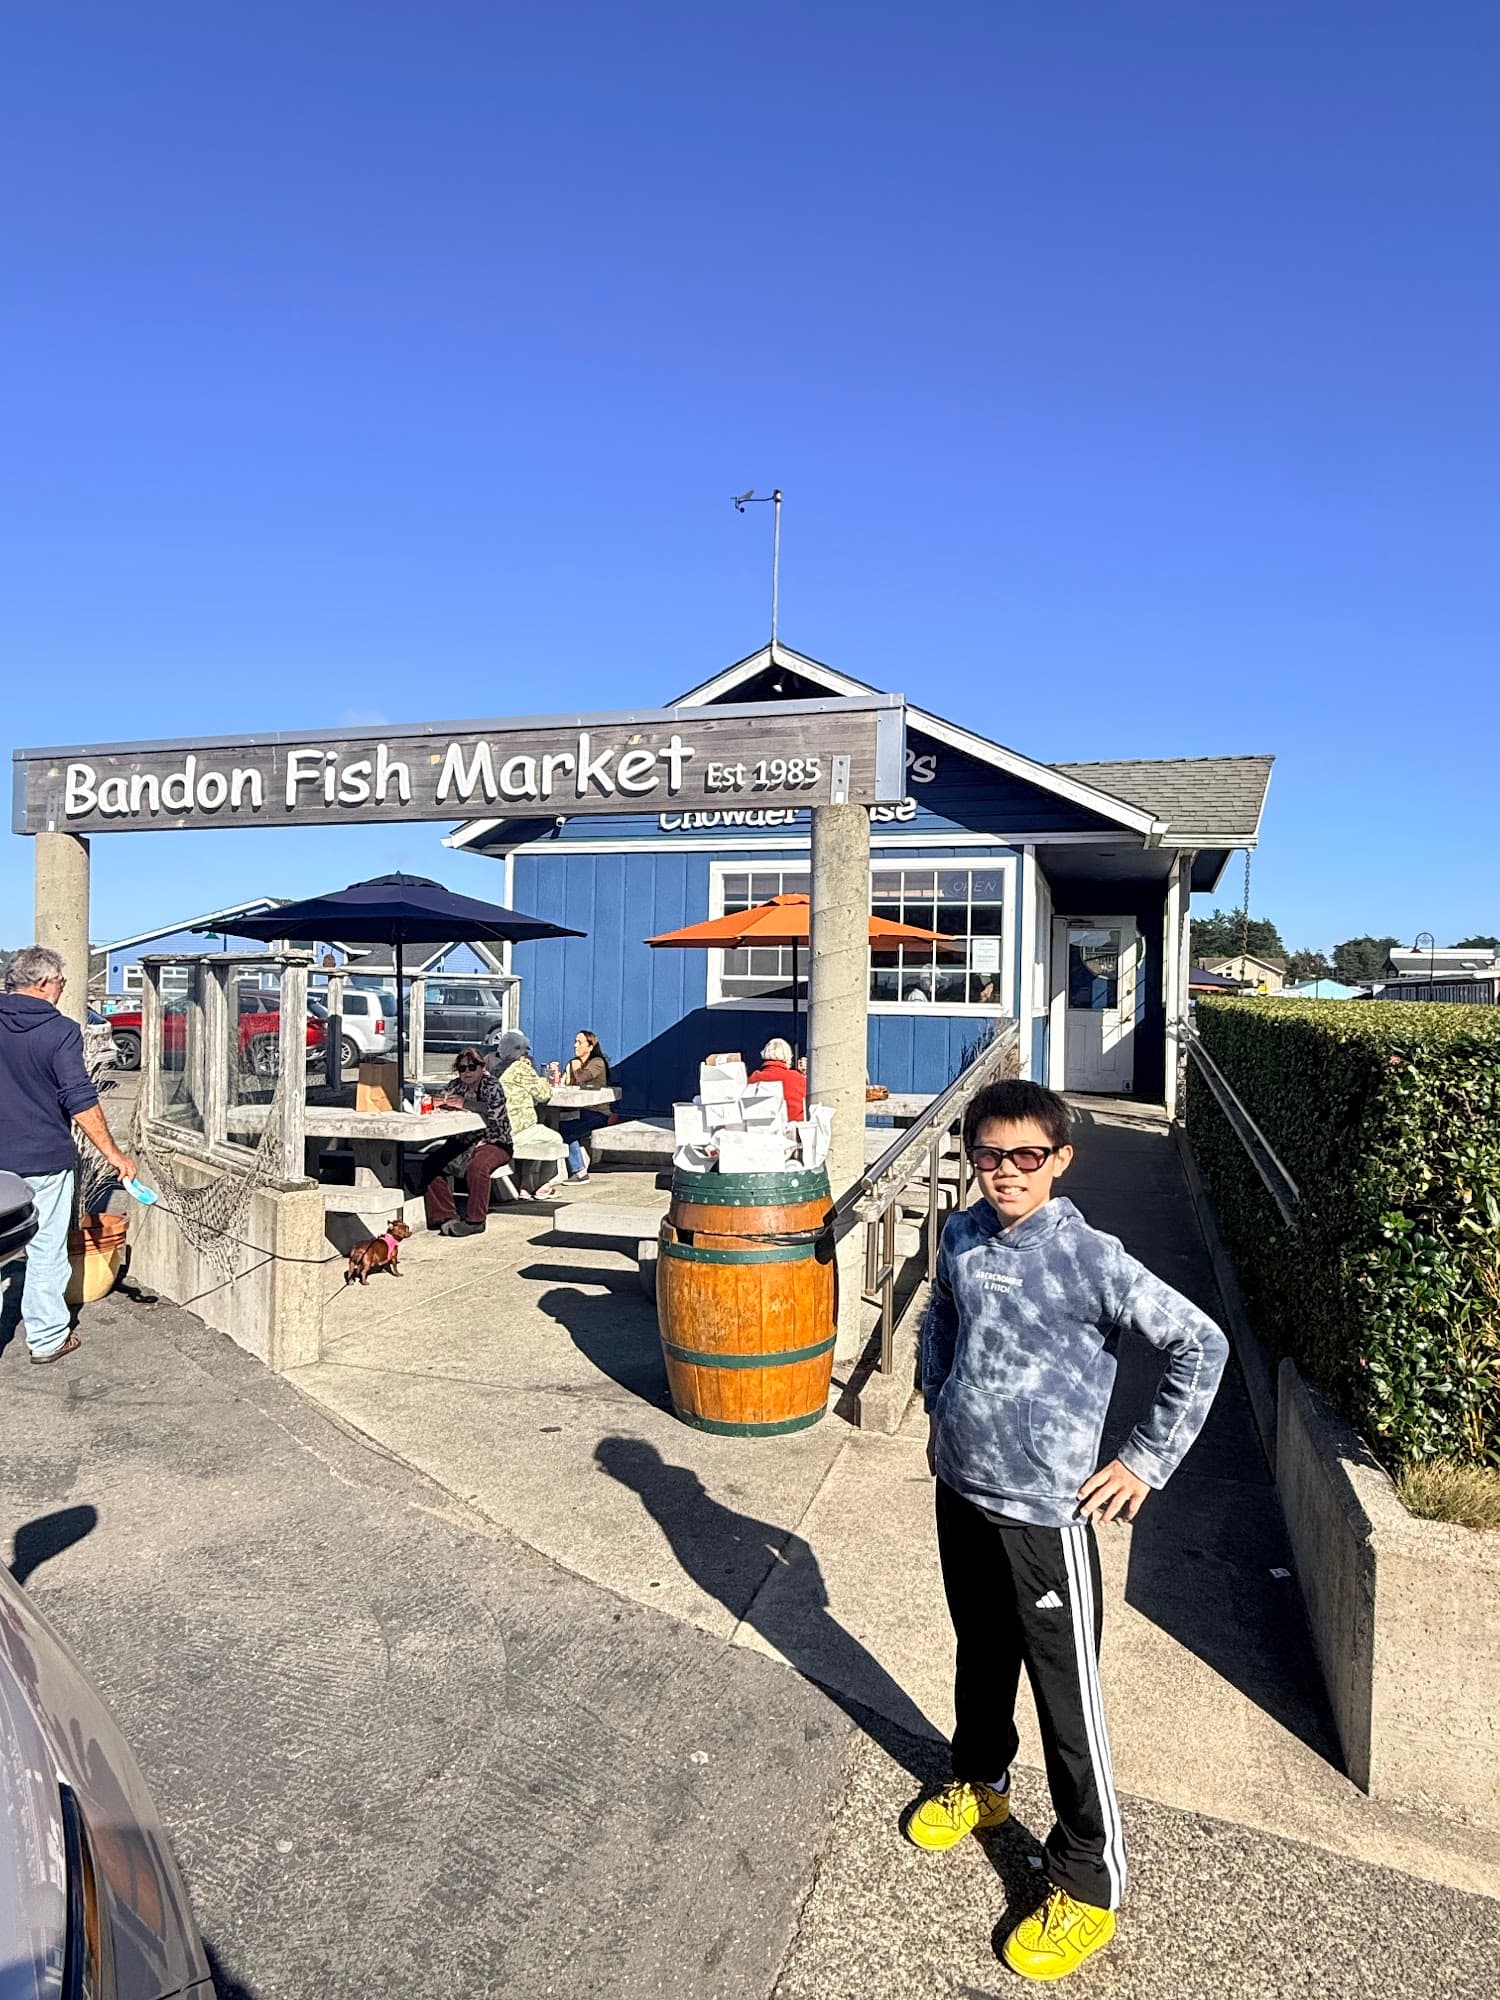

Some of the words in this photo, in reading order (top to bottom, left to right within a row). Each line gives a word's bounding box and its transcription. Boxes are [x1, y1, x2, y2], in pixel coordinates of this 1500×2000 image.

[64, 754, 263, 816] Bandon
[285, 743, 411, 806] Fish
[436, 732, 696, 799] Market
[706, 762, 747, 788] Est
[754, 757, 823, 785] 1985
